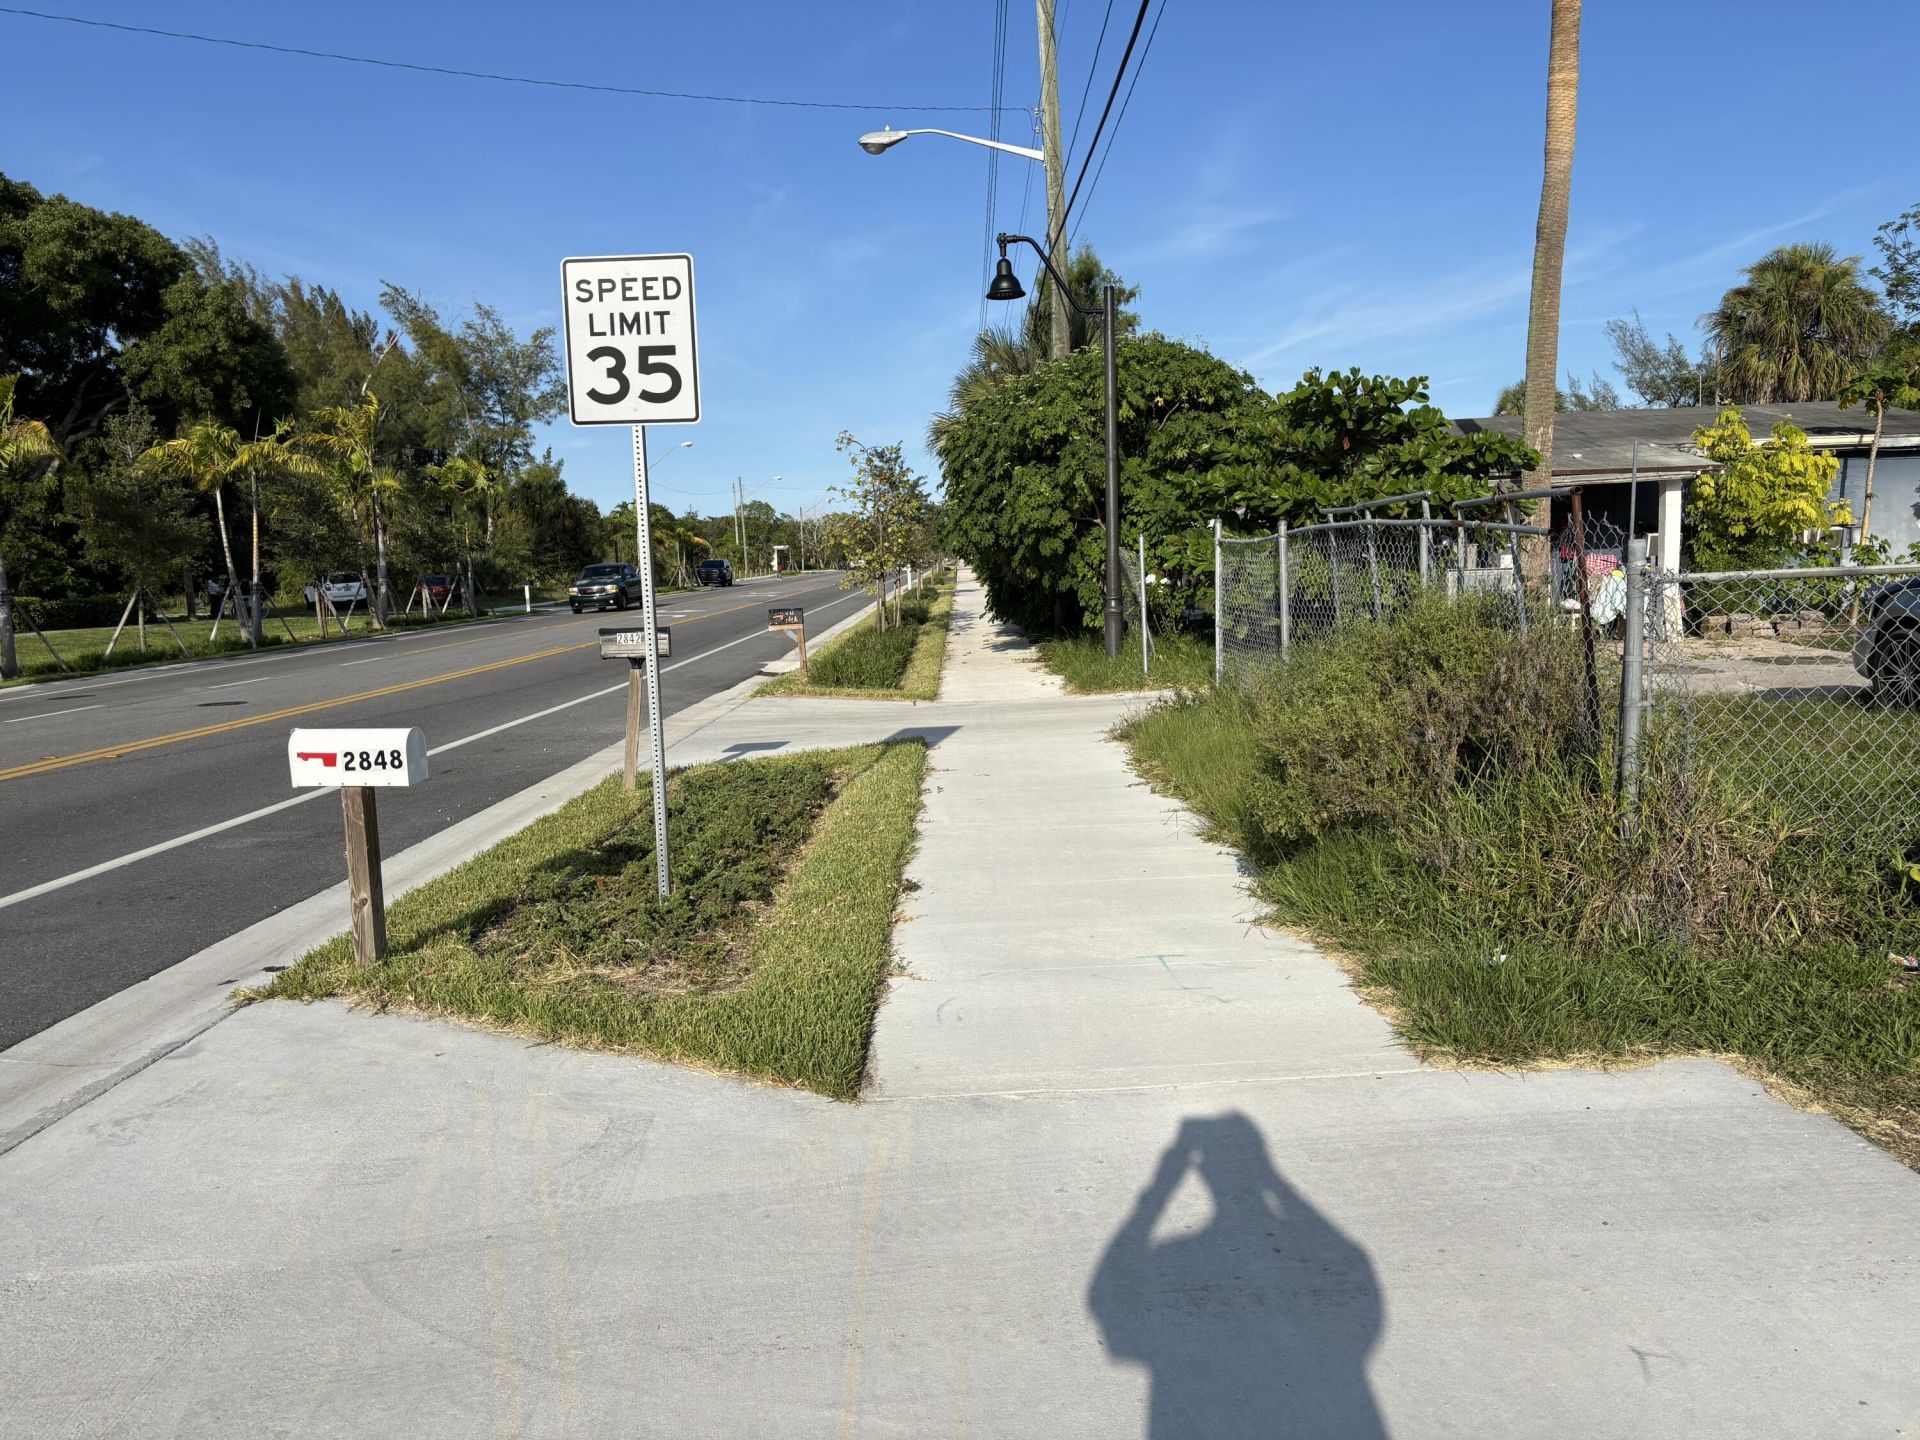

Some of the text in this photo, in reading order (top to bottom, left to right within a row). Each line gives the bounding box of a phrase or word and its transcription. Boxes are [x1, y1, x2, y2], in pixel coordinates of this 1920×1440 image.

[575, 276, 682, 303] SPEED
[588, 310, 671, 336] LIMIT
[586, 345, 682, 405] 35
[617, 633, 641, 644] 2842
[343, 749, 403, 771] 2848
